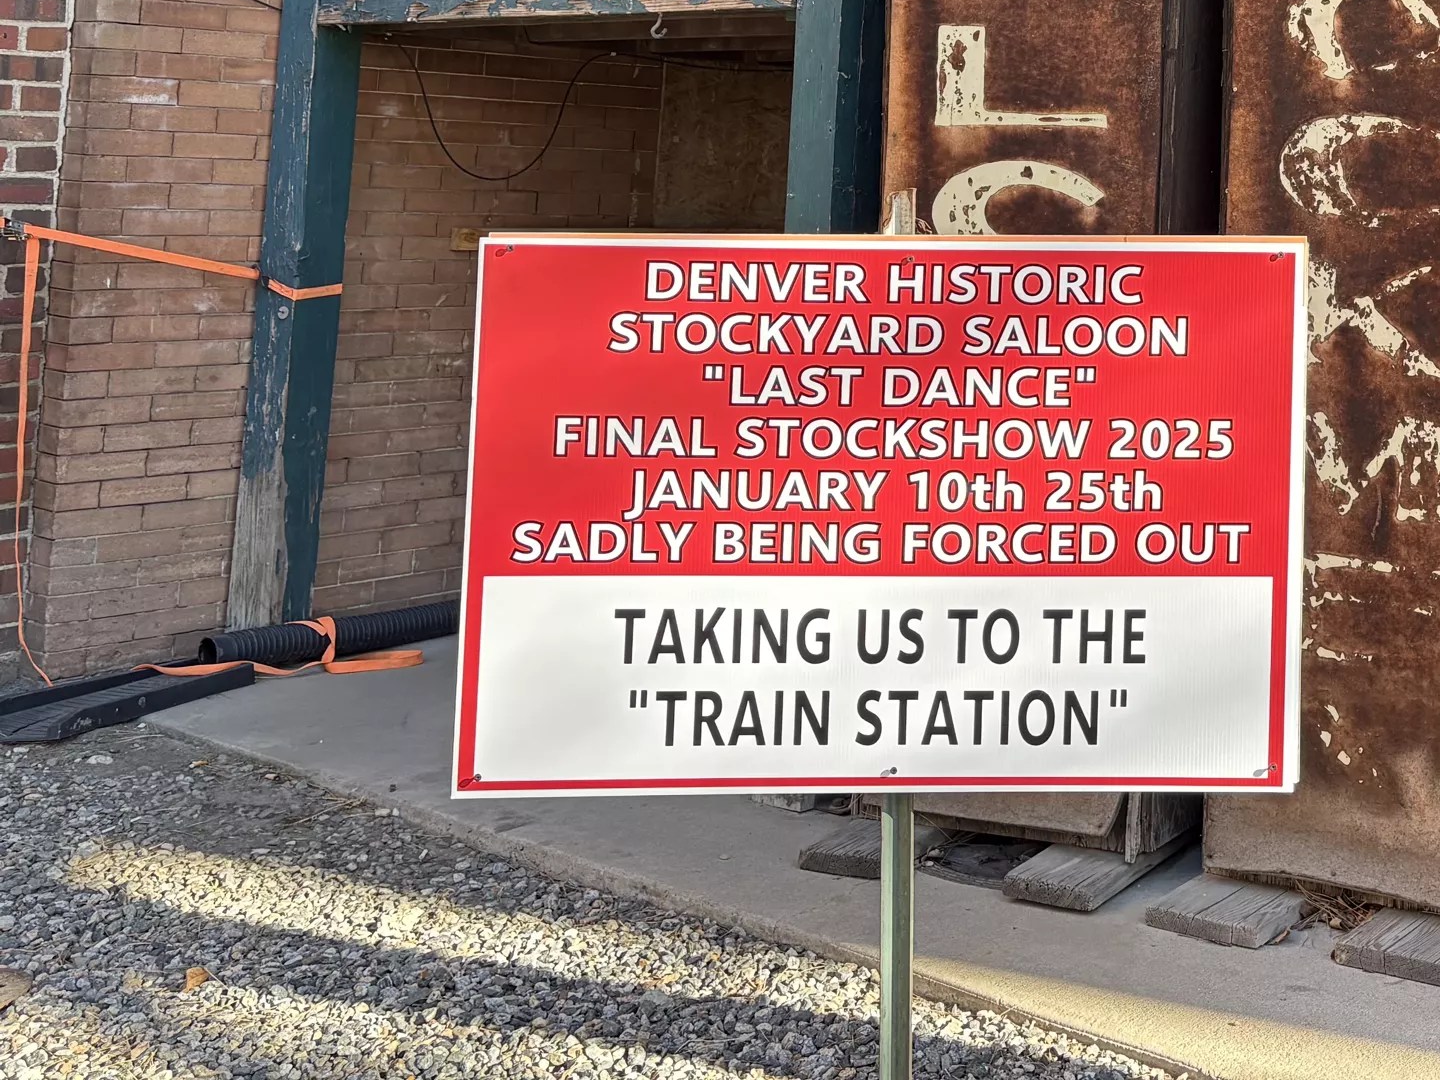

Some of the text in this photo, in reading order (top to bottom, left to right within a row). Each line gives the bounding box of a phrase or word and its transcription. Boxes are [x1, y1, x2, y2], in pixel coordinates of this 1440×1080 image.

[644, 259, 1145, 305] DENVER HISTORIC
[606, 311, 1190, 357] STOCKYARD SALOON
[702, 363, 1097, 409] "LAST DANCE"
[553, 415, 1234, 461] FINAL STOCKSHOW 2025
[621, 468, 1165, 522] JANUARY 10th 25th
[510, 520, 1252, 565] SADLY BEING FORCED OUT
[614, 606, 1147, 666] TAKING US TO THE
[628, 689, 1128, 747] "TRAIN STATION"
